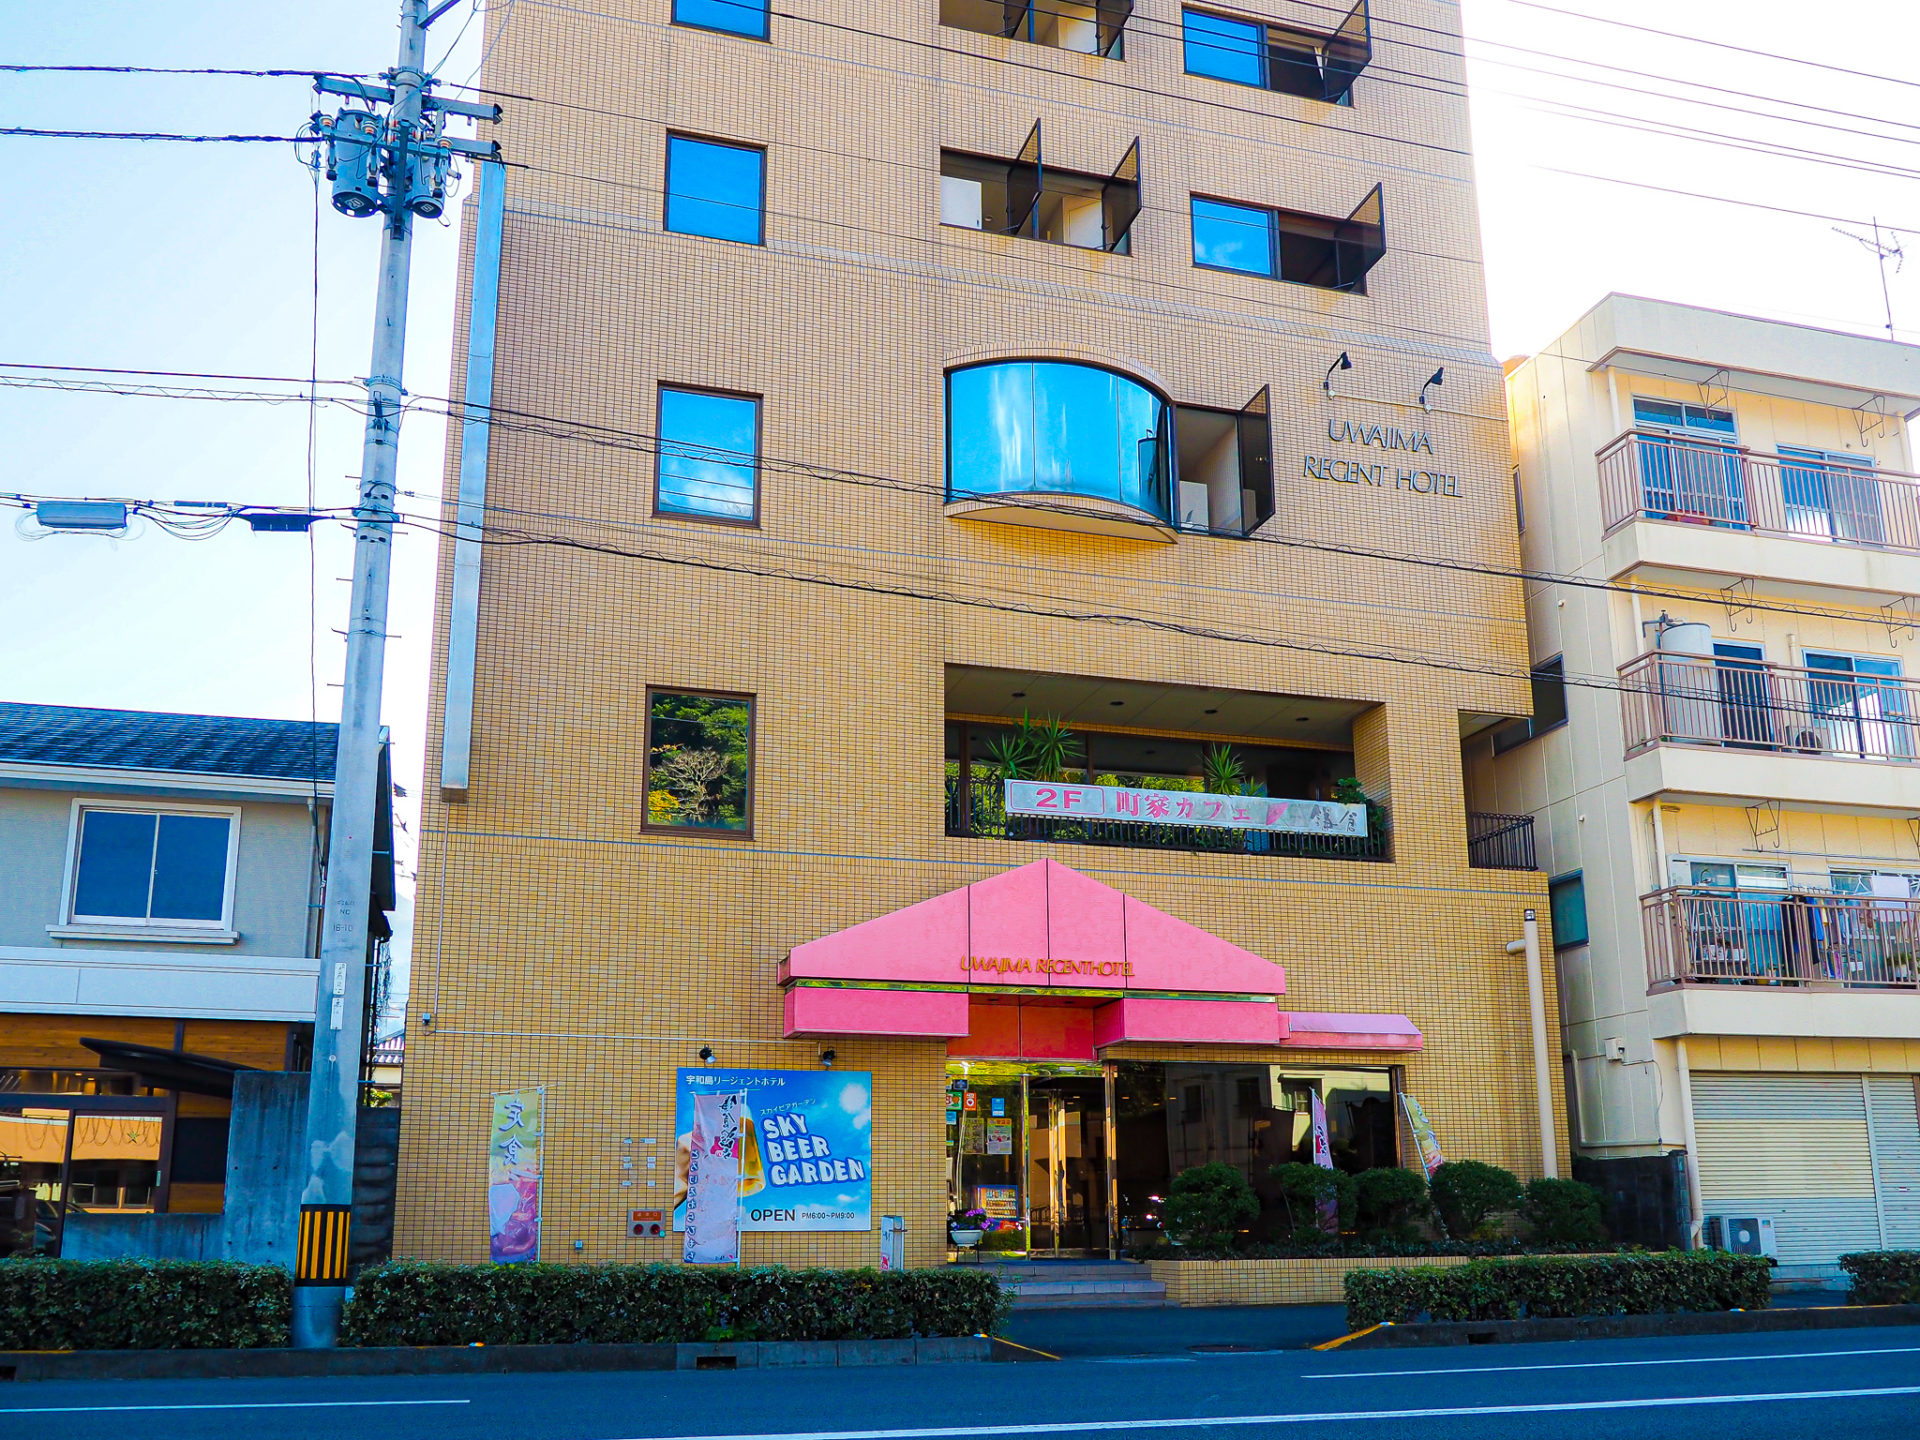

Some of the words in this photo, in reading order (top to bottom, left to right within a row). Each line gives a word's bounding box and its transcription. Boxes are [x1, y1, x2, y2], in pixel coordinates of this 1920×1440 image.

[1329, 419, 1433, 454] UWAJIMA
[1304, 455, 1387, 486] REGENT
[1397, 468, 1463, 497] HOTEL
[1036, 788, 1082, 809] 2F
[1116, 790, 1251, 822] 町家カフェ
[961, 955, 1032, 974] UWAJIMA
[686, 1075, 785, 1086] 宇和島リージェントホテル
[763, 1113, 807, 1139] SKY
[767, 1135, 830, 1162] BEER
[771, 1158, 865, 1185] GARDEN
[750, 1209, 796, 1222] OPEN
